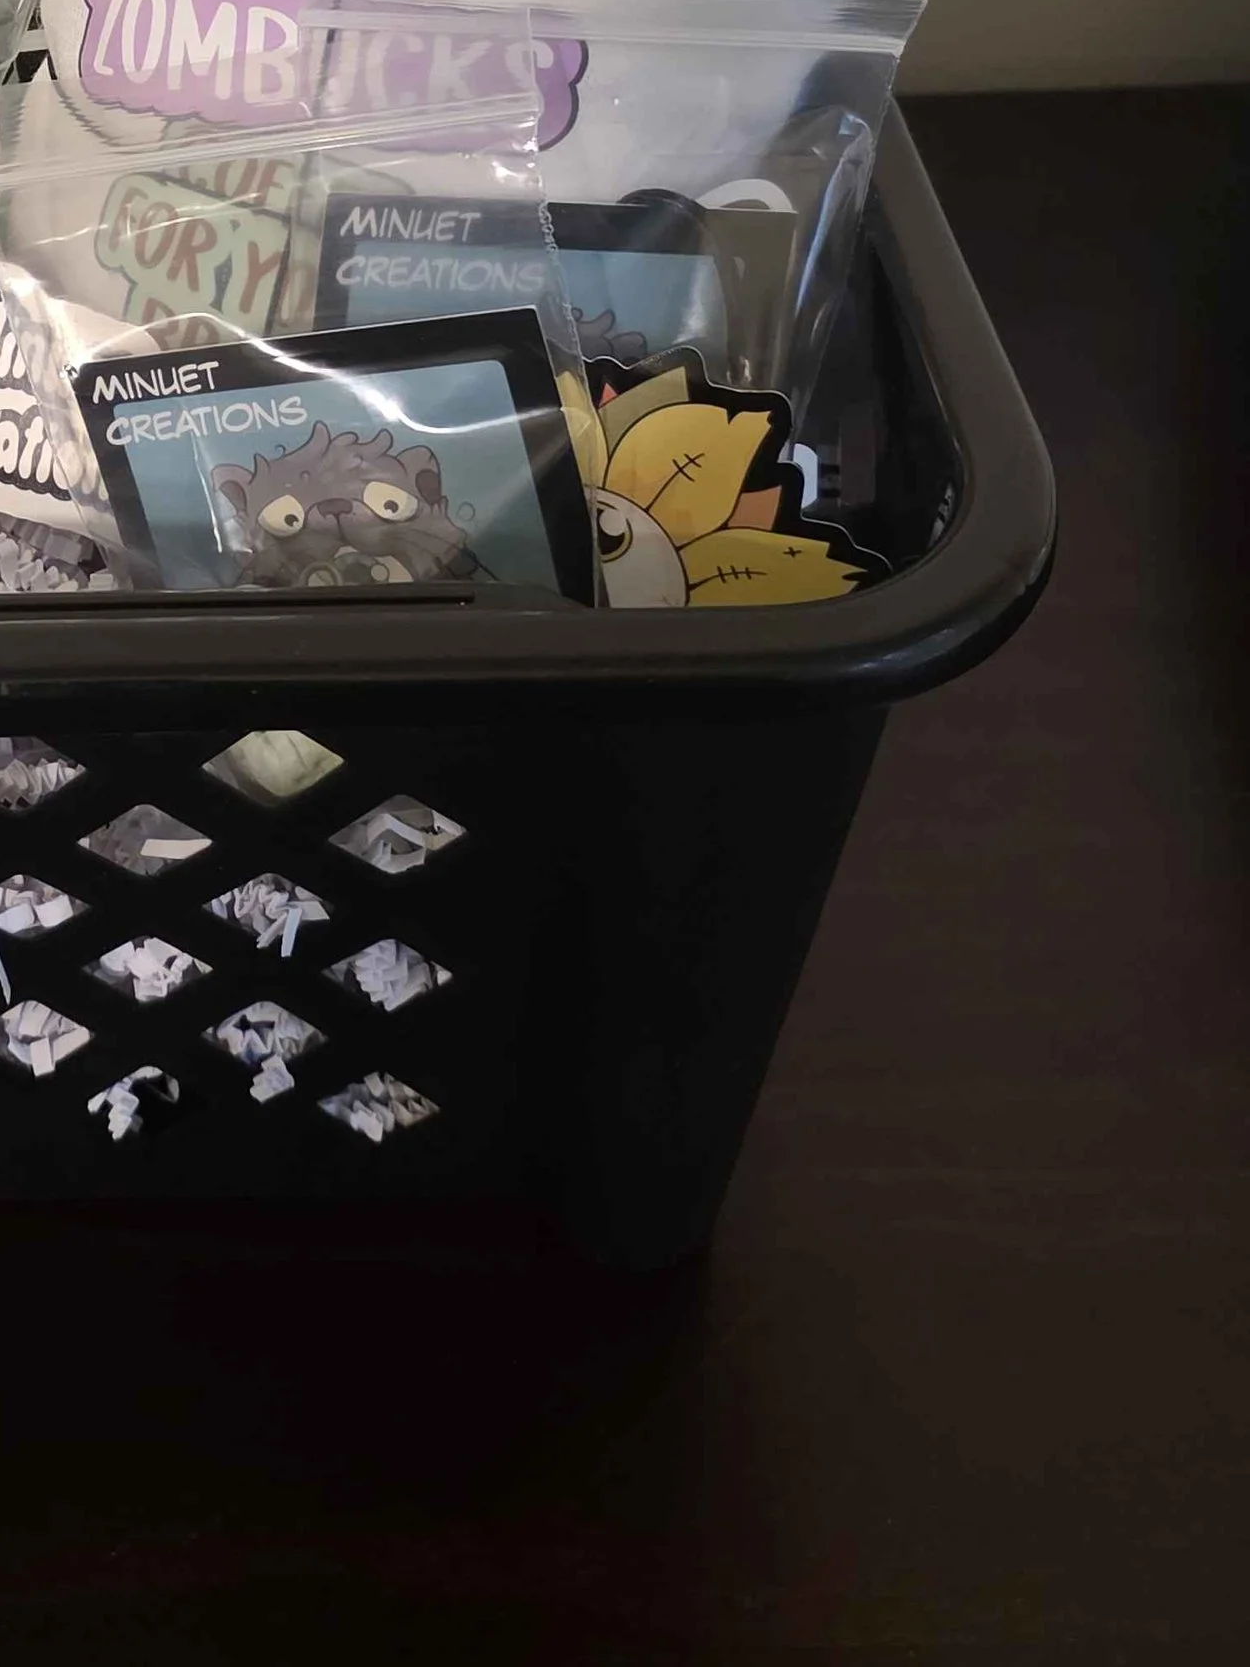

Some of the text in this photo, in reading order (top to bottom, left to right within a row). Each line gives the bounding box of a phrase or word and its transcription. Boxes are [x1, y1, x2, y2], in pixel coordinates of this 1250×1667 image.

[107, 186, 219, 292] FOR
[339, 206, 483, 243] MINUET
[335, 255, 546, 292] CREATIONS
[92, 360, 221, 405] MINUET
[105, 395, 308, 447] CREATIONS
